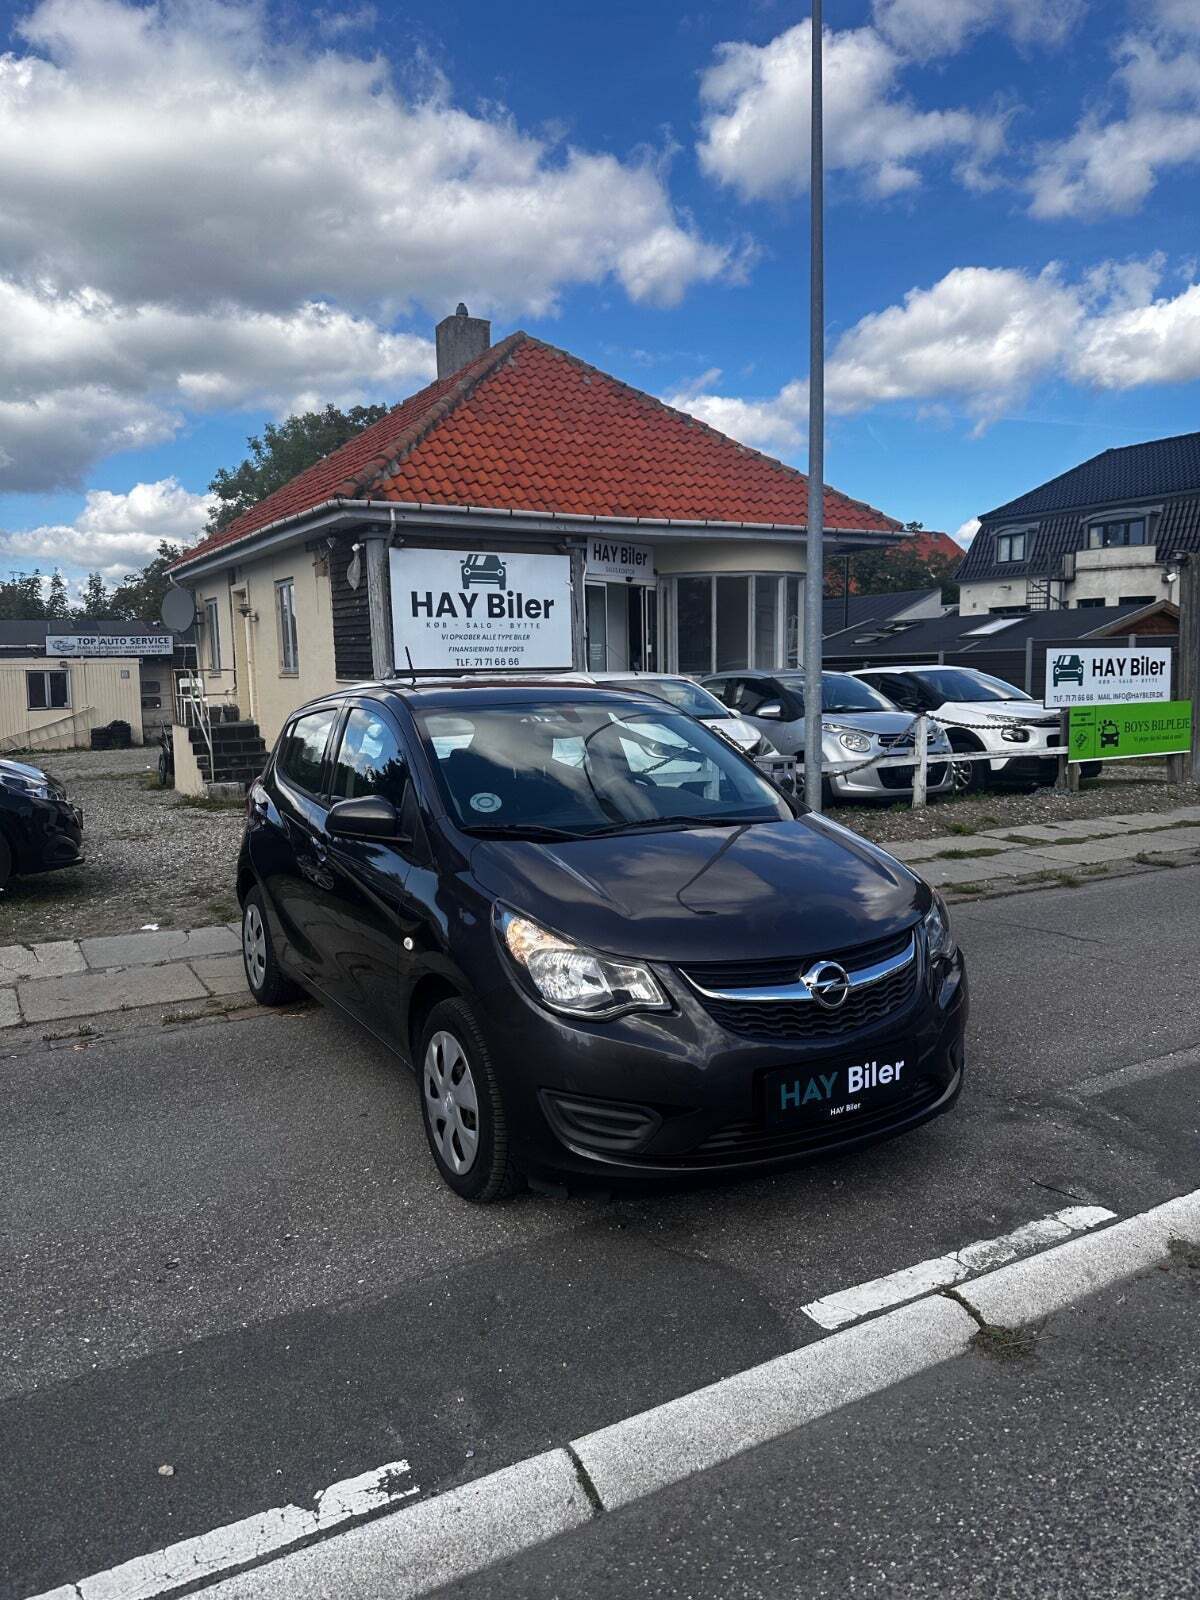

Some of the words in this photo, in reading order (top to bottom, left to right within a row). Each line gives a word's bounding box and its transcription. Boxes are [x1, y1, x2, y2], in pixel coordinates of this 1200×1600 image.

[593, 544, 618, 563] HAY
[621, 546, 648, 566] Biler
[411, 591, 479, 618] HAY
[487, 590, 555, 619] Biler
[426, 621, 447, 629] KØB
[77, 637, 97, 645] TOP
[99, 637, 127, 645] AUTO
[130, 637, 170, 645] SERVICE
[456, 658, 473, 667] TLF.
[1092, 658, 1126, 677] HAY
[1131, 656, 1166, 676] Biler
[1124, 720, 1150, 733] BOYS
[1151, 718, 1190, 731] BILPLEJE
[781, 1071, 838, 1110] HAY
[848, 1060, 905, 1093] Biler
[830, 1105, 845, 1116] HAY
[846, 1103, 861, 1112] Biler
